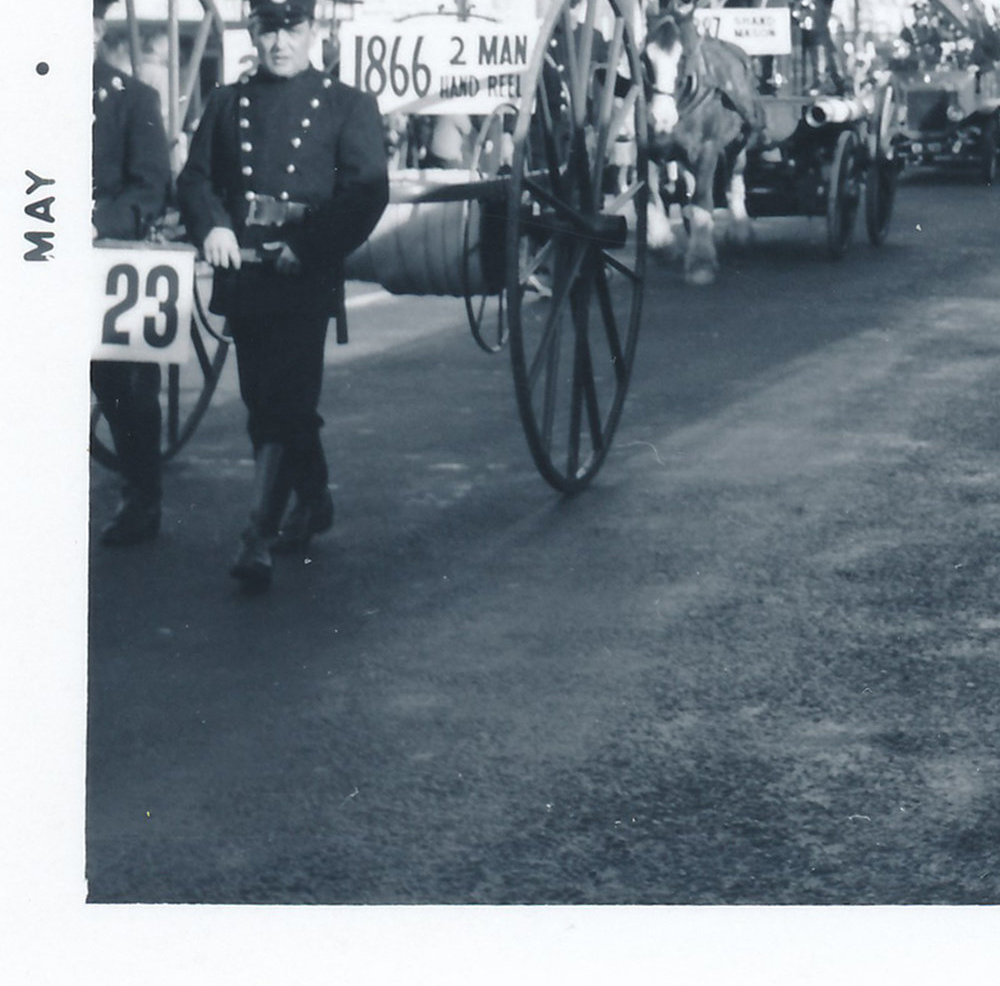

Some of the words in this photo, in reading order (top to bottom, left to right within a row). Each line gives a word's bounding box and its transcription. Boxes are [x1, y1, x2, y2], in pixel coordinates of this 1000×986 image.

[354, 34, 432, 98] 1866
[449, 35, 467, 66] 2
[478, 35, 528, 66] MAN
[439, 74, 481, 99] HAND
[487, 73, 523, 99] REEL
[101, 263, 180, 349] 23
